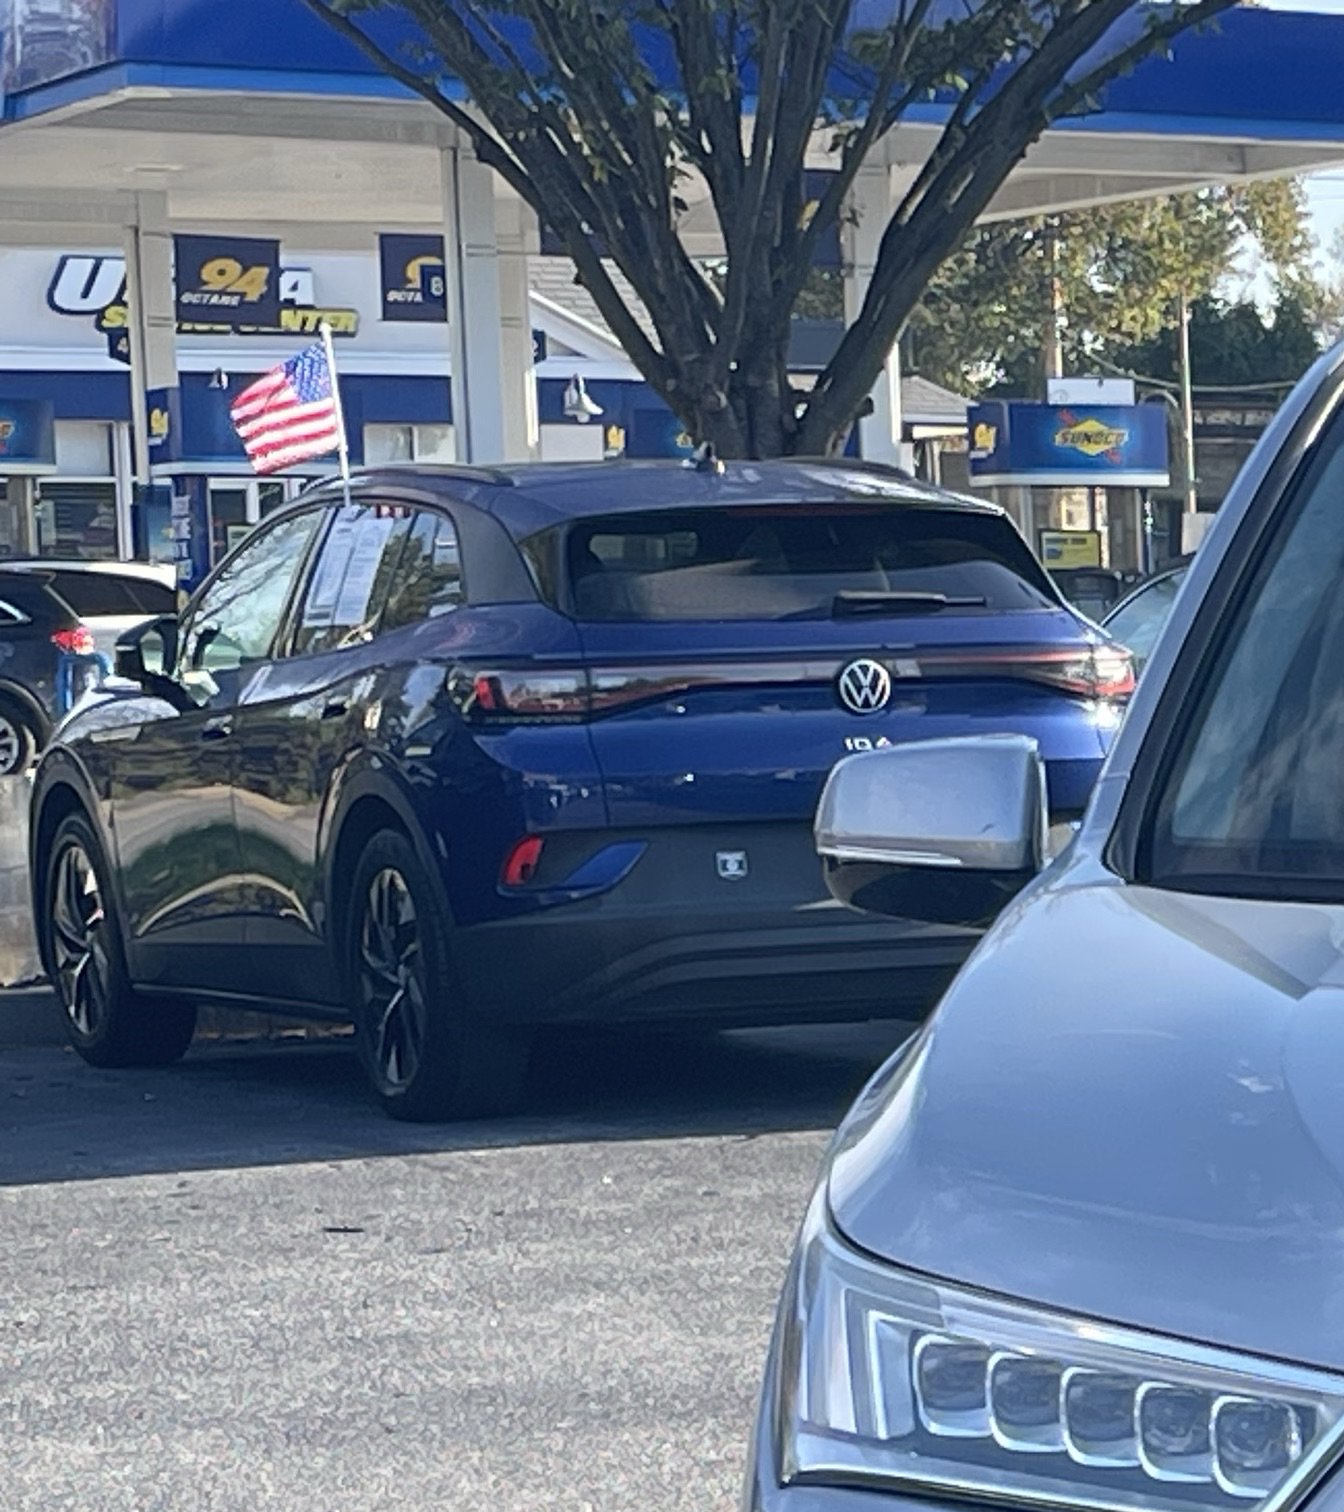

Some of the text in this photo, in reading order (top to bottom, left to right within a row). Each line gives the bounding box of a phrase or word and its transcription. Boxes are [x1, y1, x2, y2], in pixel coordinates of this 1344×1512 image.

[200, 257, 270, 301] 94
[180, 291, 241, 308] OCTANE
[386, 289, 424, 304] OCTA
[1059, 428, 1128, 447] SUNOCO
